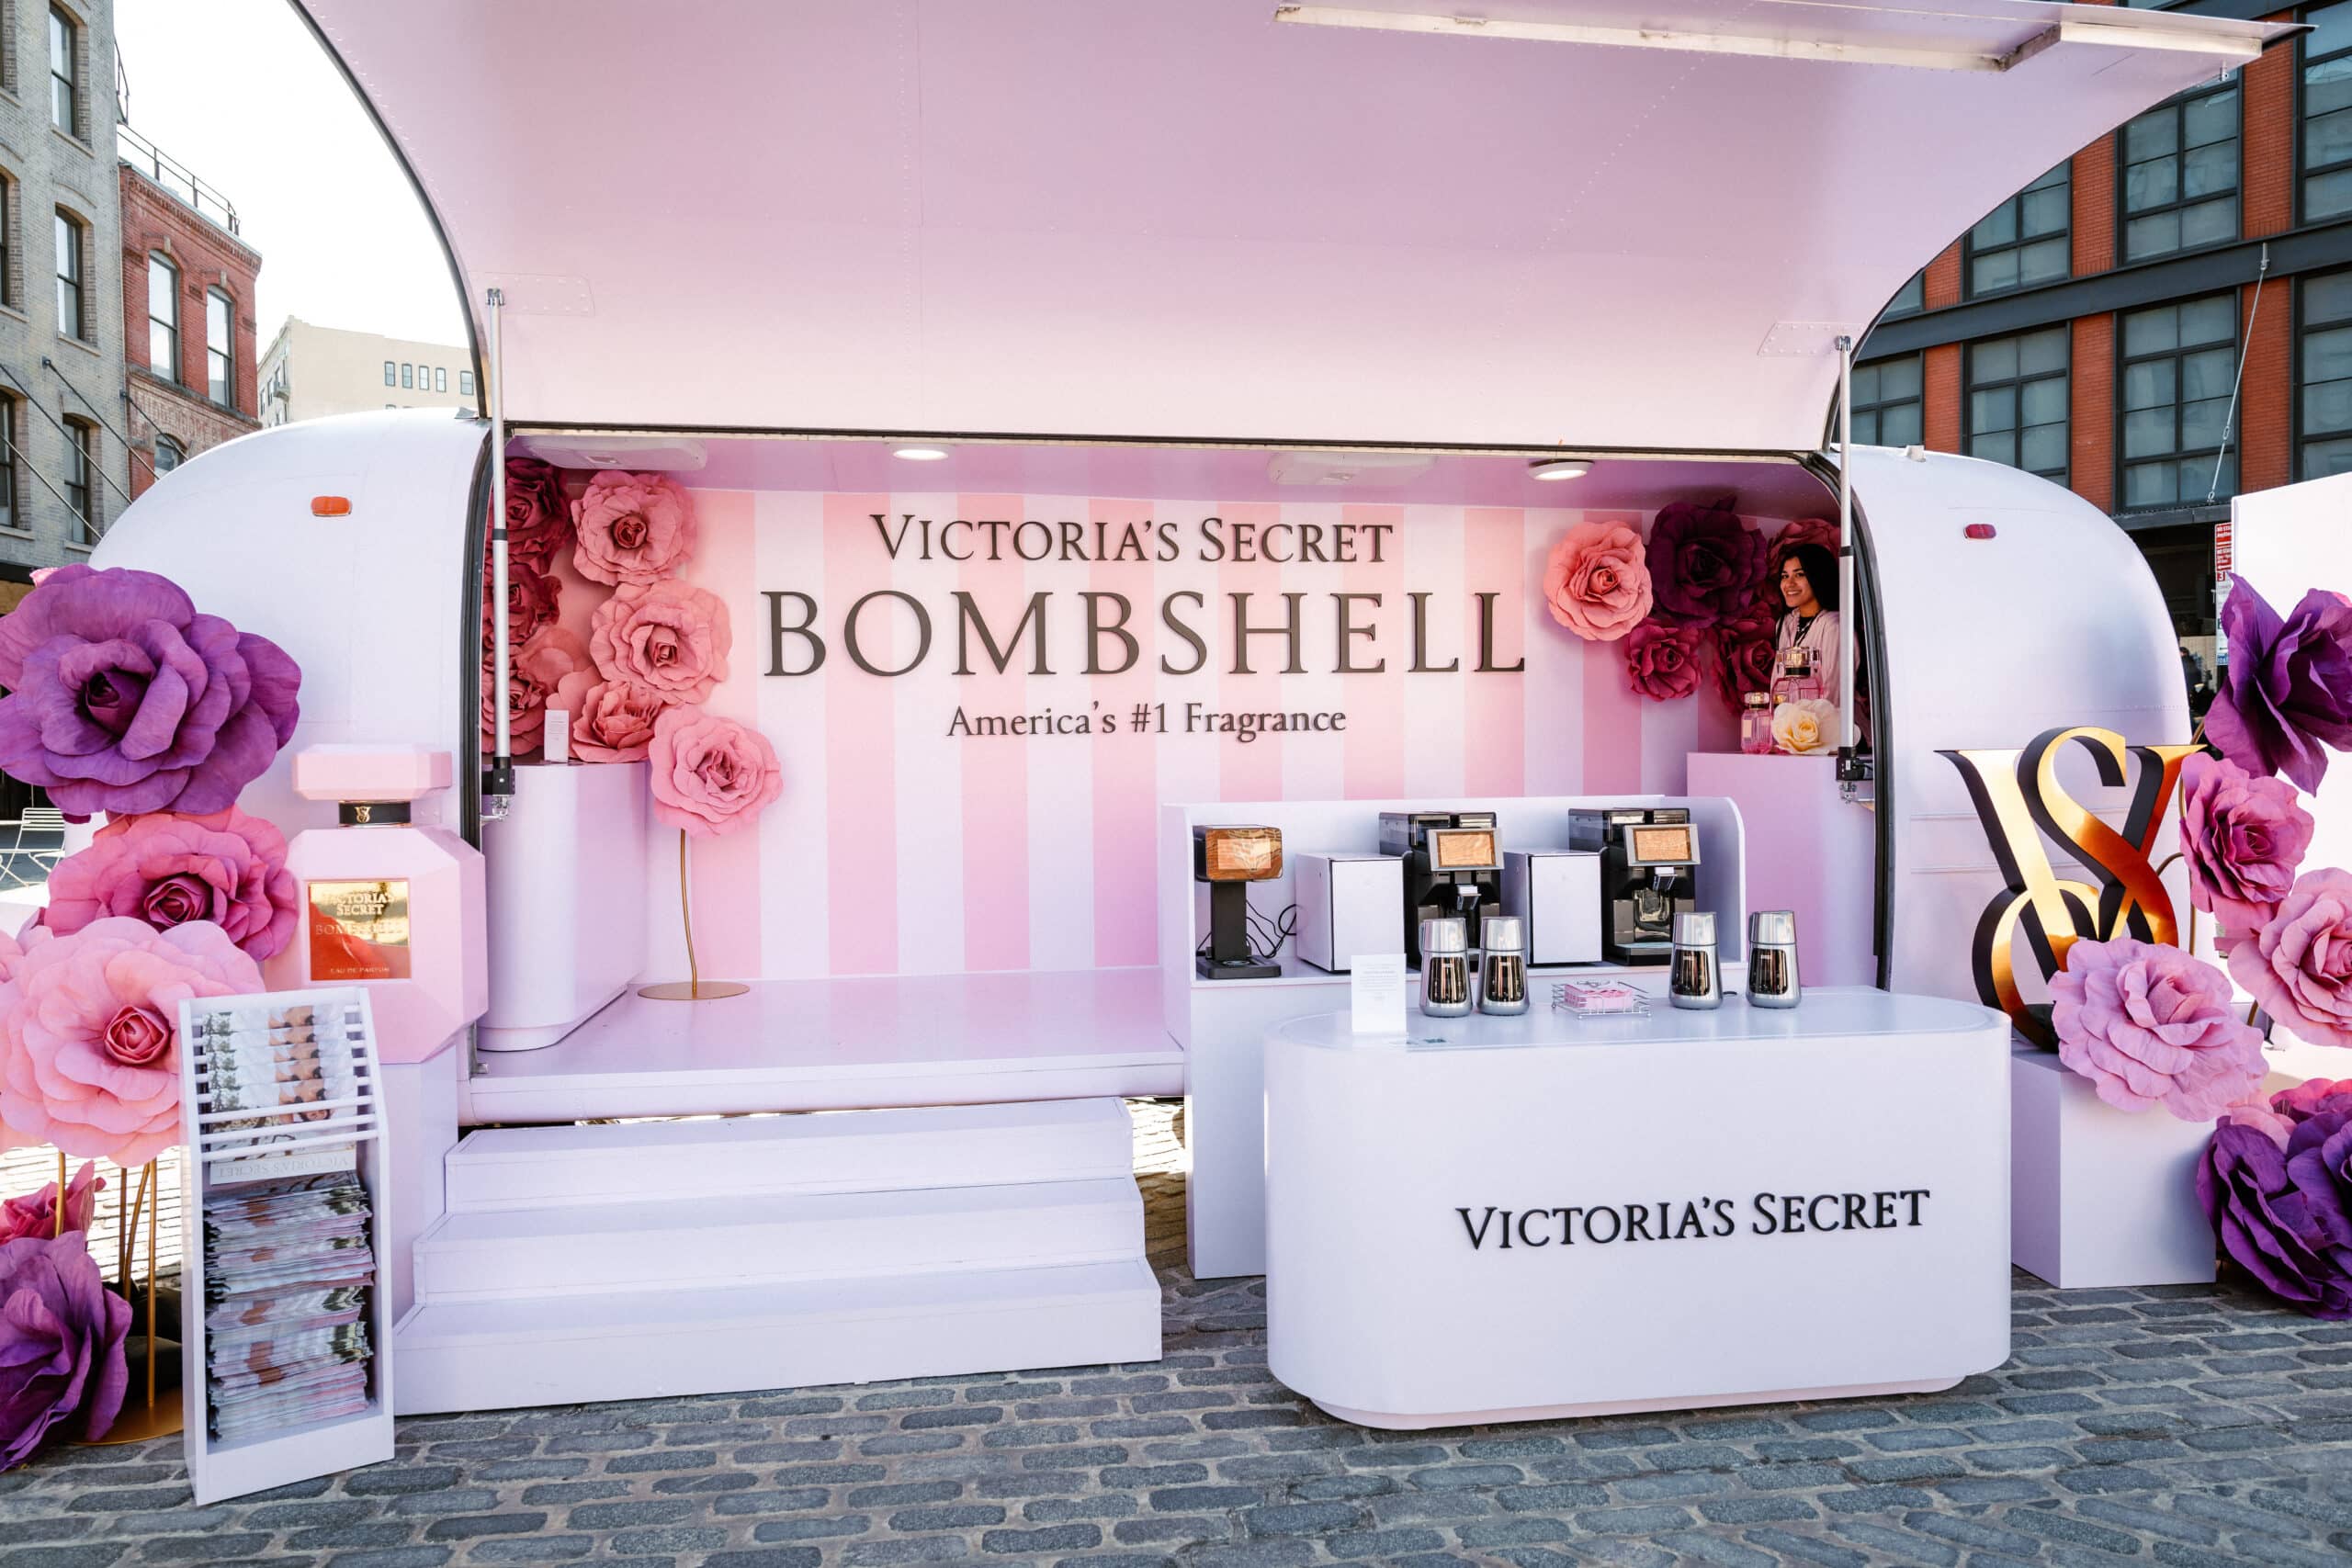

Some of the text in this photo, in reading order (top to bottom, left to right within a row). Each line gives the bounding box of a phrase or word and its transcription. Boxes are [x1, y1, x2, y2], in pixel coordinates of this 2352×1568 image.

[868, 513, 1395, 563] VICTORIA'S SECRET
[760, 590, 1526, 677] BOMBSHELL
[947, 701, 1347, 743] America's #1 Fragrance
[322, 891, 394, 906] CTORIA'S
[336, 903, 384, 916] SECRET
[1454, 1189, 1931, 1251] VICTORIA'S SECRET
